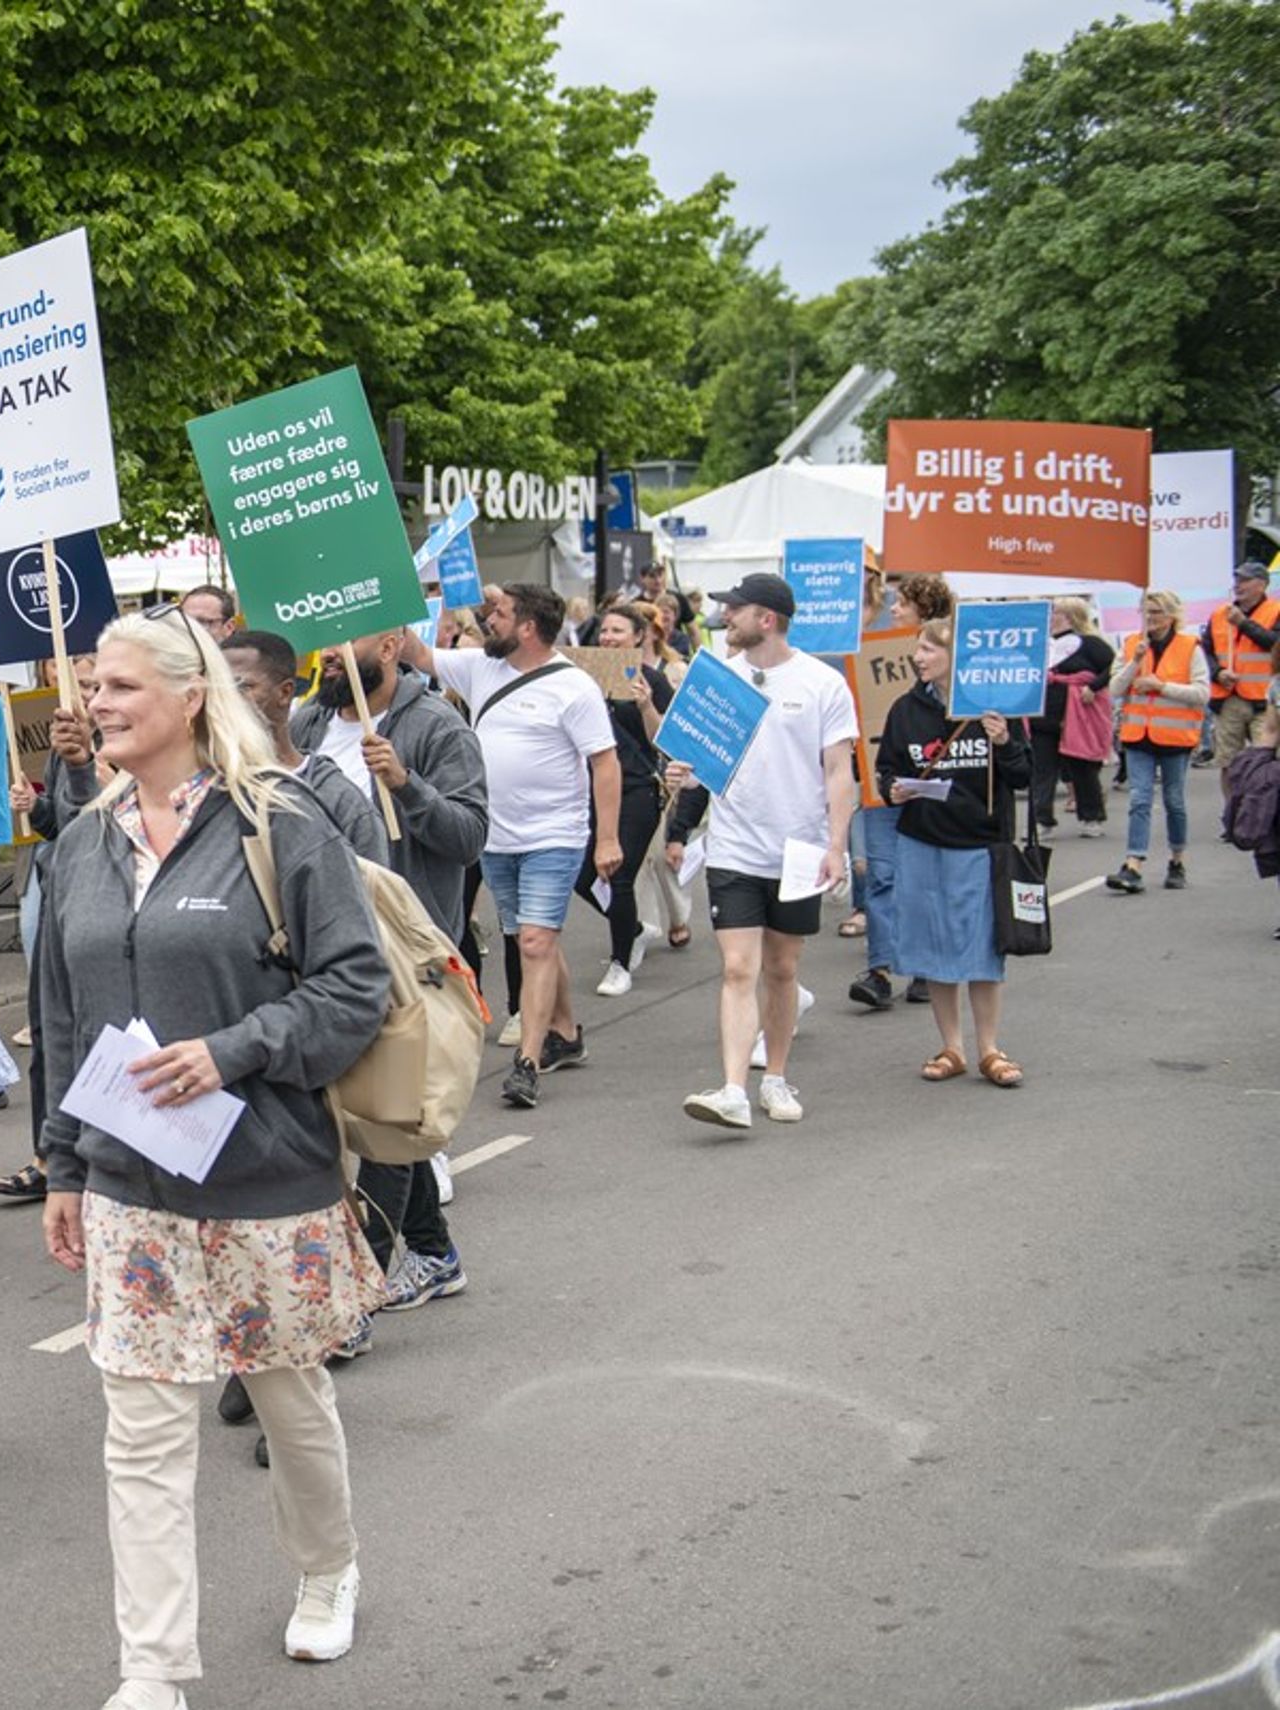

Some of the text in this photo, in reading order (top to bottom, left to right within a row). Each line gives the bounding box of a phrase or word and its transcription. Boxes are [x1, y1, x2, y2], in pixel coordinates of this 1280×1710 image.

[19, 366, 72, 406] TAK
[227, 406, 334, 456] Uden os vil
[12, 457, 69, 483] Fonden for
[229, 435, 348, 485] færre fædre
[916, 448, 1123, 490] Billig i drift,
[14, 469, 90, 500] Socialt Ansvar
[234, 458, 361, 510] engagere sig
[423, 464, 483, 515] LOV
[508, 470, 597, 520] ORDEN
[228, 479, 380, 540] i deres børns liv
[885, 483, 1148, 528] dyr at undvære
[988, 536, 1055, 555] High five
[275, 590, 345, 622] baba
[966, 627, 1039, 650] STØT
[957, 667, 1042, 686] VENNER
